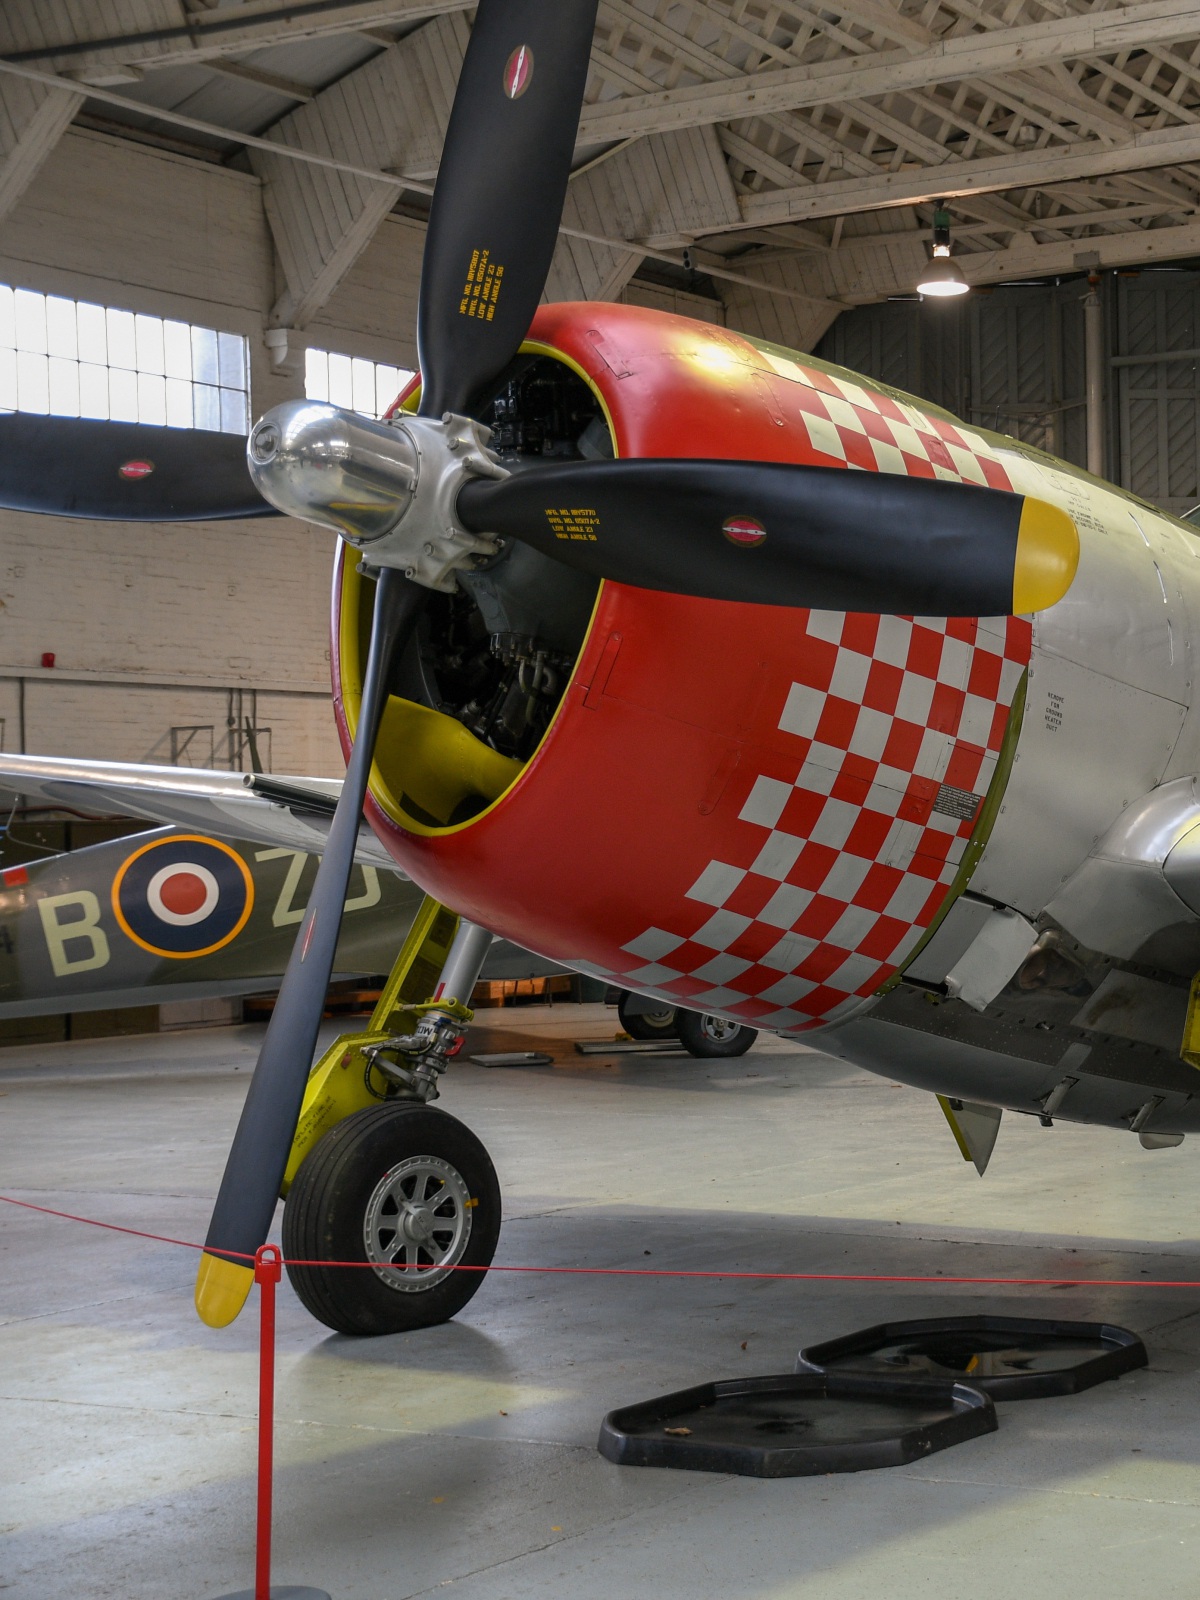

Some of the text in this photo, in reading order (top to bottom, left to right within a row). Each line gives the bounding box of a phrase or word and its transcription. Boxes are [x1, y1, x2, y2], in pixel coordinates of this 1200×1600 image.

[464, 283, 472, 295] NO.
[473, 285, 481, 297] NO.
[477, 264, 495, 318] LOW ANGLE 23
[486, 304, 495, 321] HIGH
[491, 278, 501, 303] ANGLE
[37, 890, 111, 977] B
